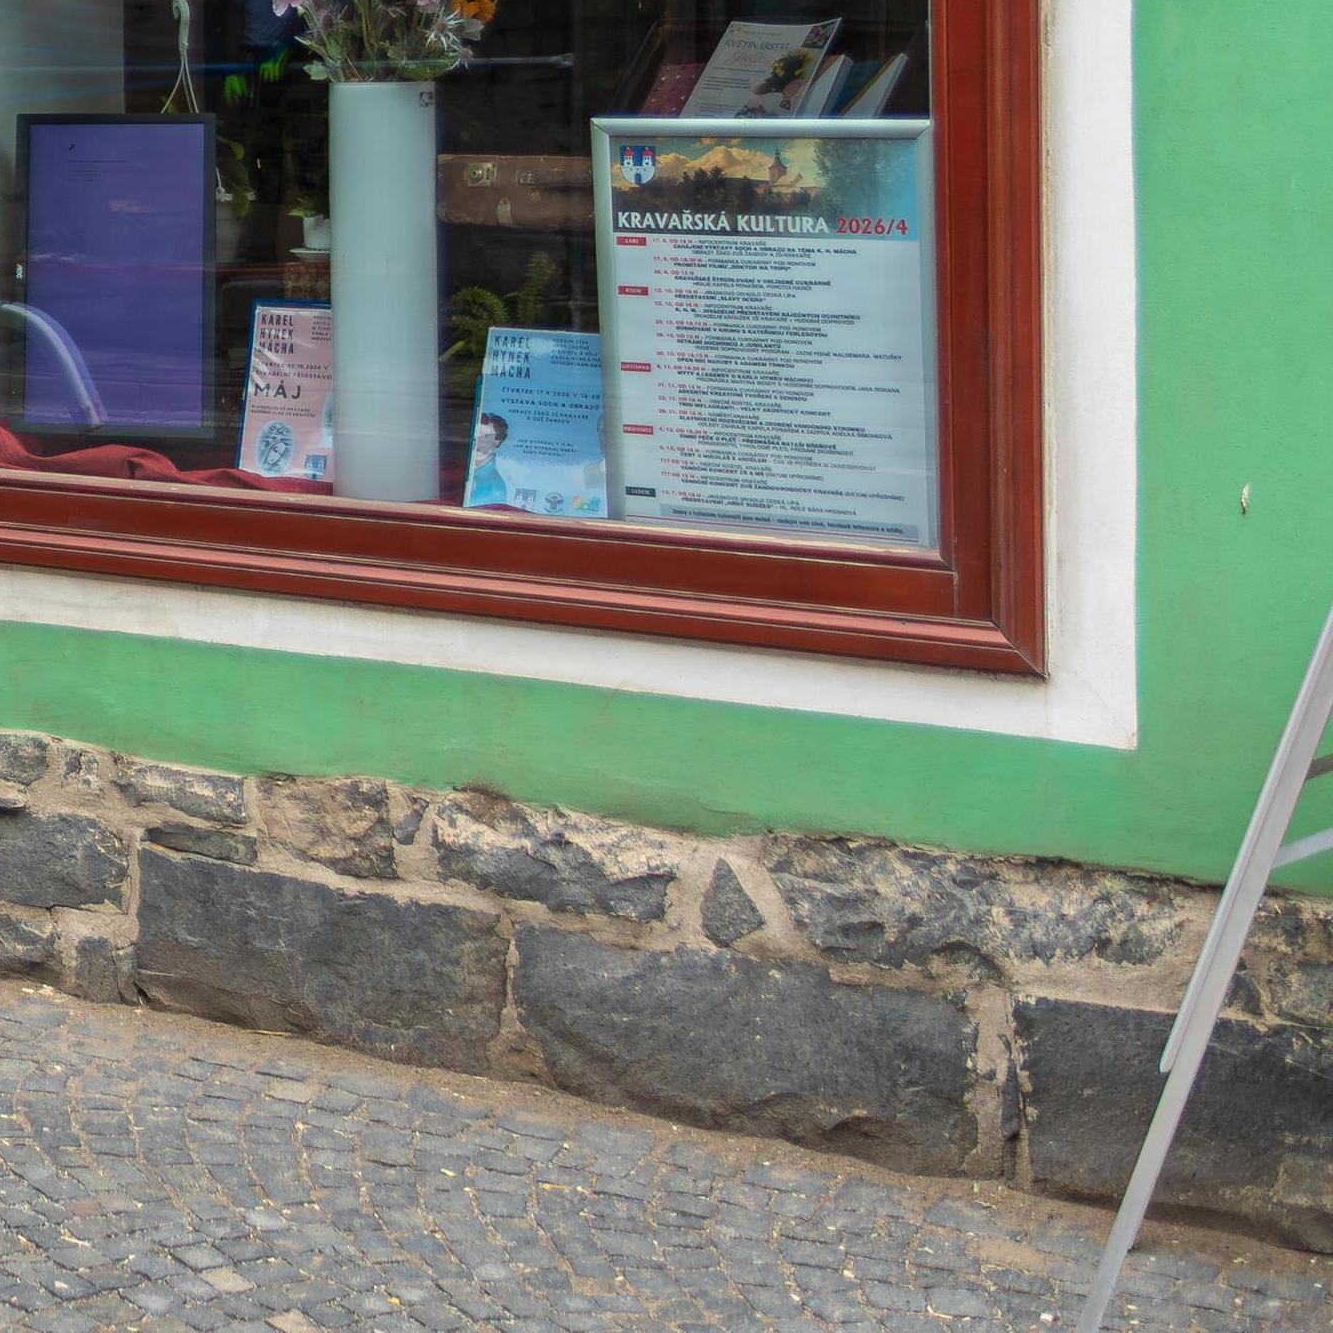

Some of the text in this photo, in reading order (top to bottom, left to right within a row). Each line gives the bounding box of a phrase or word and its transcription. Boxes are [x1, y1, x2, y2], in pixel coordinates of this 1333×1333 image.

[617, 210, 909, 236] KRAVAŘSKÁ KULTURA 2026/4
[261, 314, 294, 327] KAREL
[494, 335, 531, 349] KAREL
[492, 350, 531, 364] HYNEK
[254, 380, 302, 400] MÁJ
[538, 400, 558, 408] SOCH
